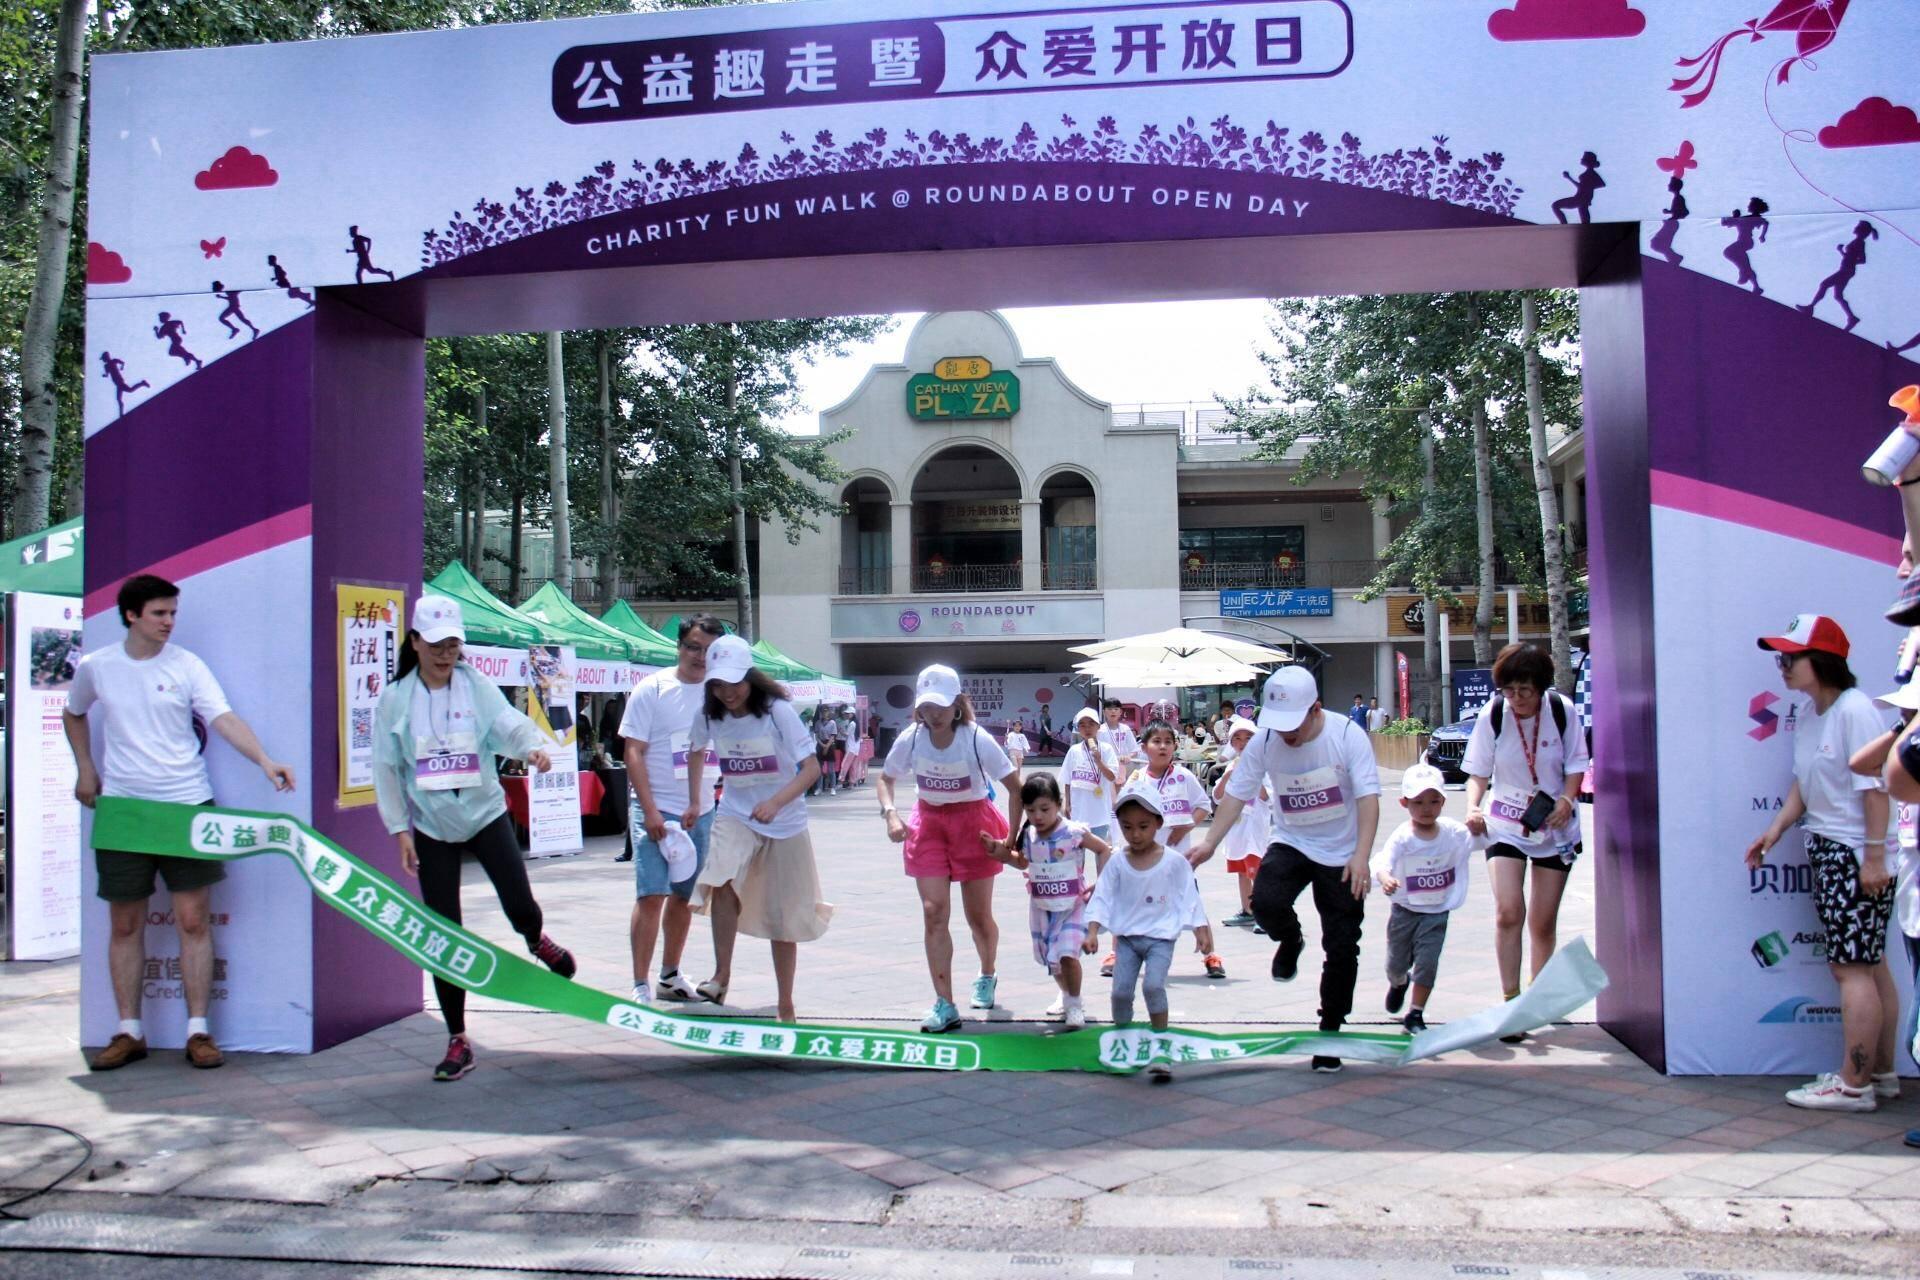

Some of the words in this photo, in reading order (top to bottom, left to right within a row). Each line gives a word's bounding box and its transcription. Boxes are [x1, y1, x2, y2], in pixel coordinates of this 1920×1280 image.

[573, 36, 922, 109] 公益趣走暨
[975, 16, 1302, 83] 众爱开放日
[587, 213, 711, 254] CHARITY
[726, 202, 781, 226] FUN
[796, 191, 876, 216] WALK
[892, 190, 910, 208] @
[926, 184, 1135, 204] ROUNDABOUT
[1152, 188, 1232, 209] OPEN
[1248, 195, 1309, 218] DAY
[915, 384, 968, 395] CATHAY
[973, 382, 1008, 393] VIEW
[915, 393, 1011, 416] PLZA
[931, 605, 1035, 617] ROUNDABOUT
[1223, 609, 1252, 617] HEALTHY
[963, 678, 1004, 687] ARITY
[428, 755, 469, 771] 0079
[729, 759, 764, 771] 0091
[926, 778, 960, 790] 0086
[1289, 791, 1329, 808] 0083
[1752, 796, 1783, 810] MA
[1750, 863, 1812, 894] 贝加
[1036, 882, 1069, 895] 0088
[350, 885, 477, 975] 众爱开放日
[619, 1011, 784, 1050] 公益趣走暨
[807, 1036, 958, 1066] 众爱开放日
